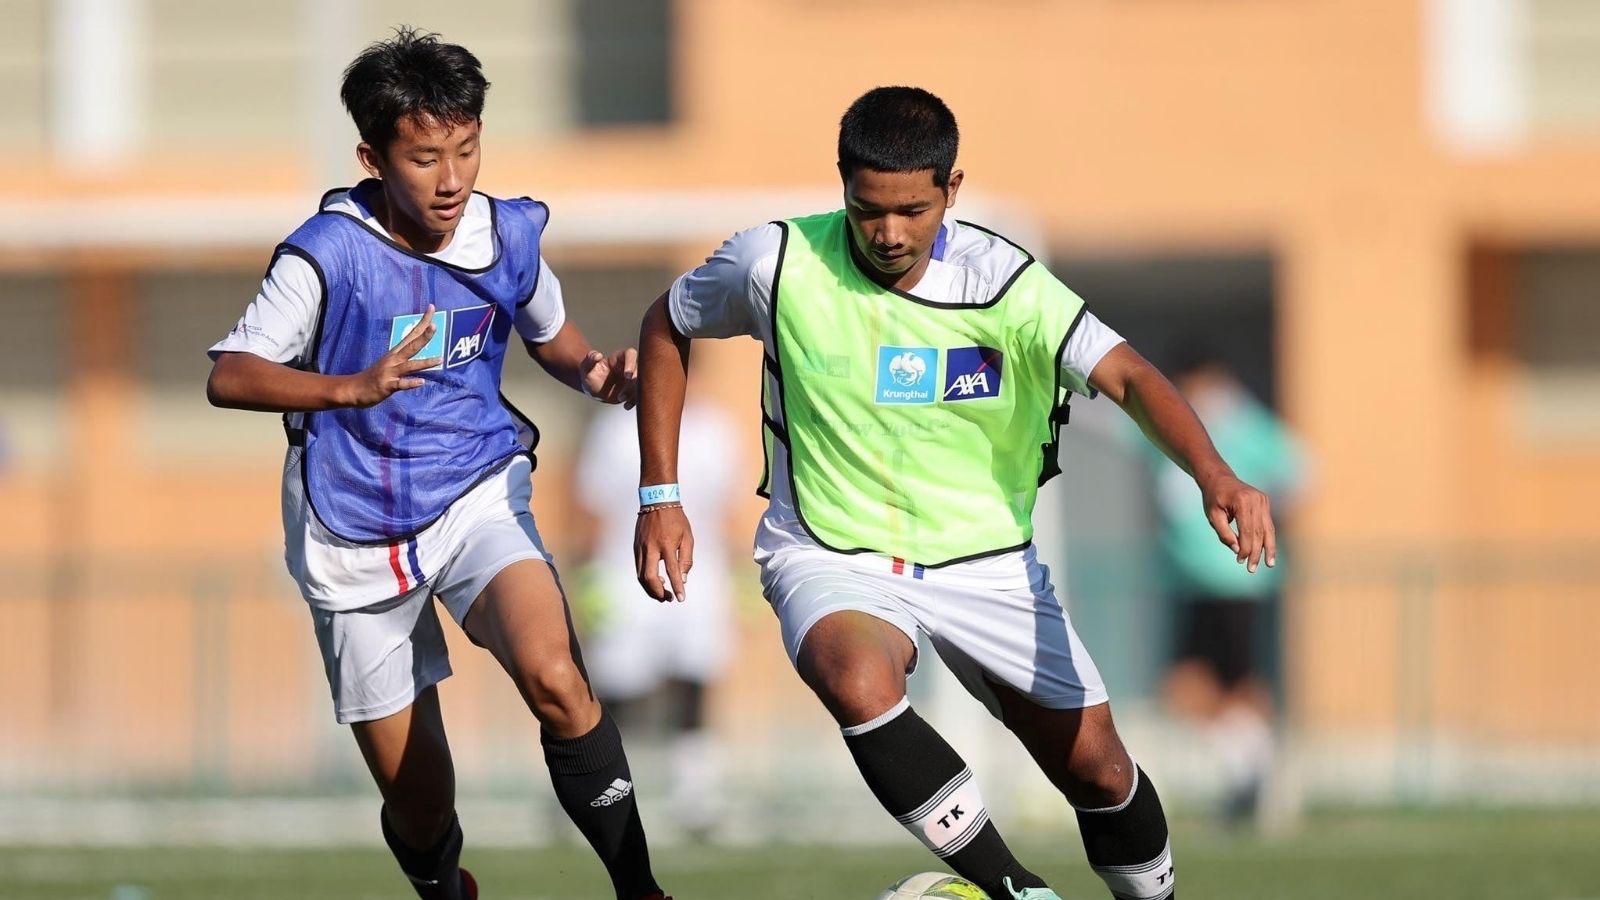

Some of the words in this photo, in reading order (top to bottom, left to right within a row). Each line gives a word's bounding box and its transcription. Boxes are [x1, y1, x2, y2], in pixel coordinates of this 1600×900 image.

[449, 333, 480, 358] AXA
[883, 389, 928, 400] Krungthai
[944, 372, 990, 396] AXA
[590, 781, 632, 807] adidas
[937, 804, 964, 828] TK
